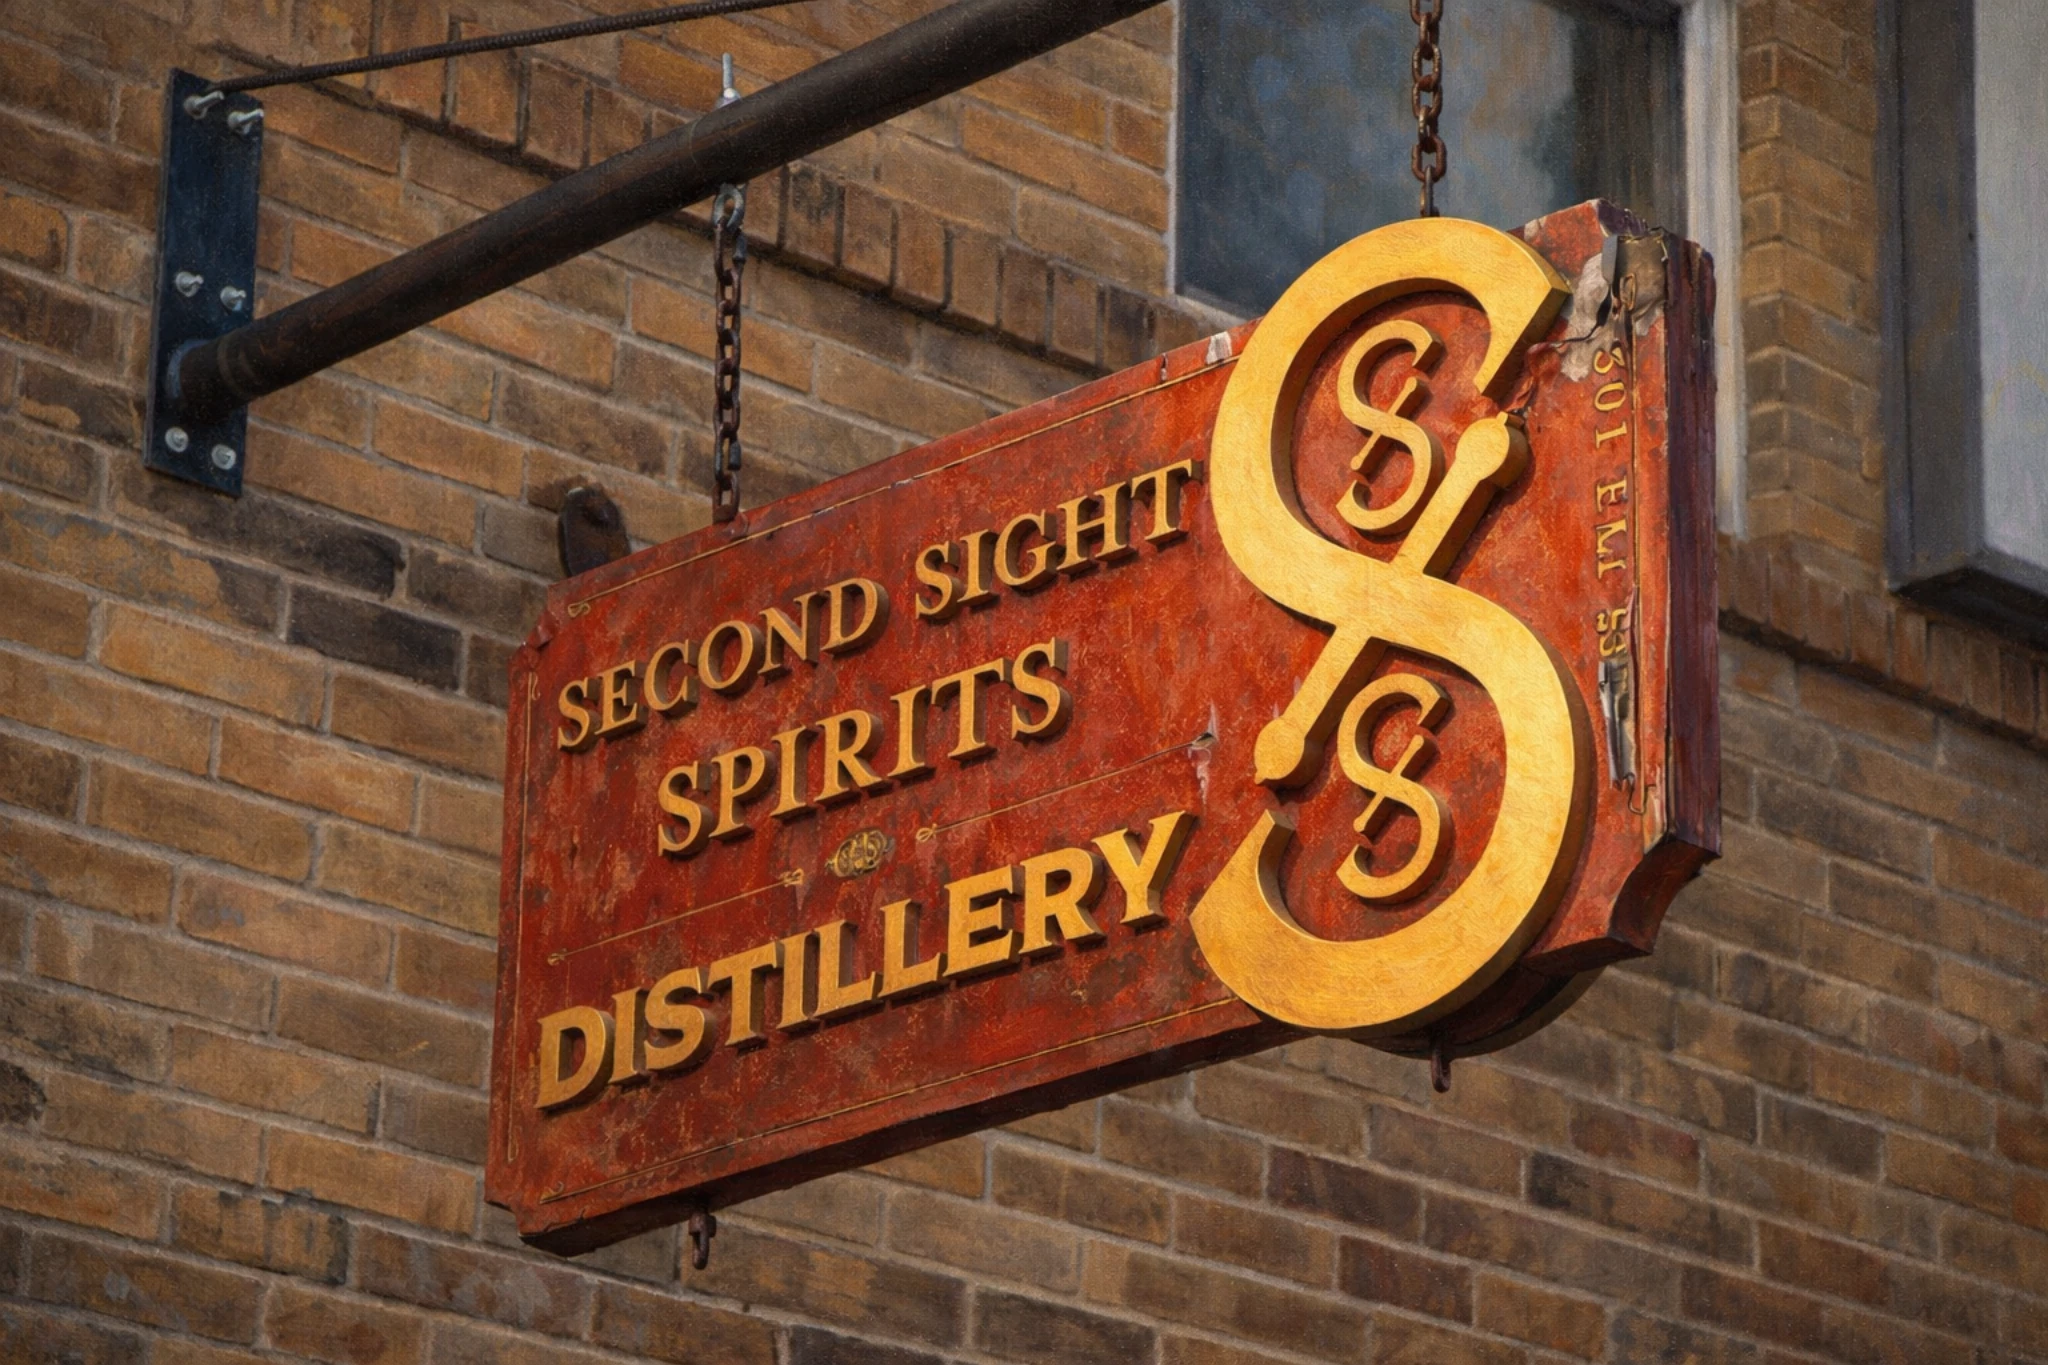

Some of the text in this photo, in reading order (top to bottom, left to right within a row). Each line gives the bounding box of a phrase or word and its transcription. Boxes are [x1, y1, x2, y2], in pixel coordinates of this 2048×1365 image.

[1593, 346, 1629, 450] 301
[556, 458, 1201, 753] SECOND SIGHT
[656, 636, 1070, 857] SPIRITS
[535, 809, 1196, 1111] DISTILLERY
